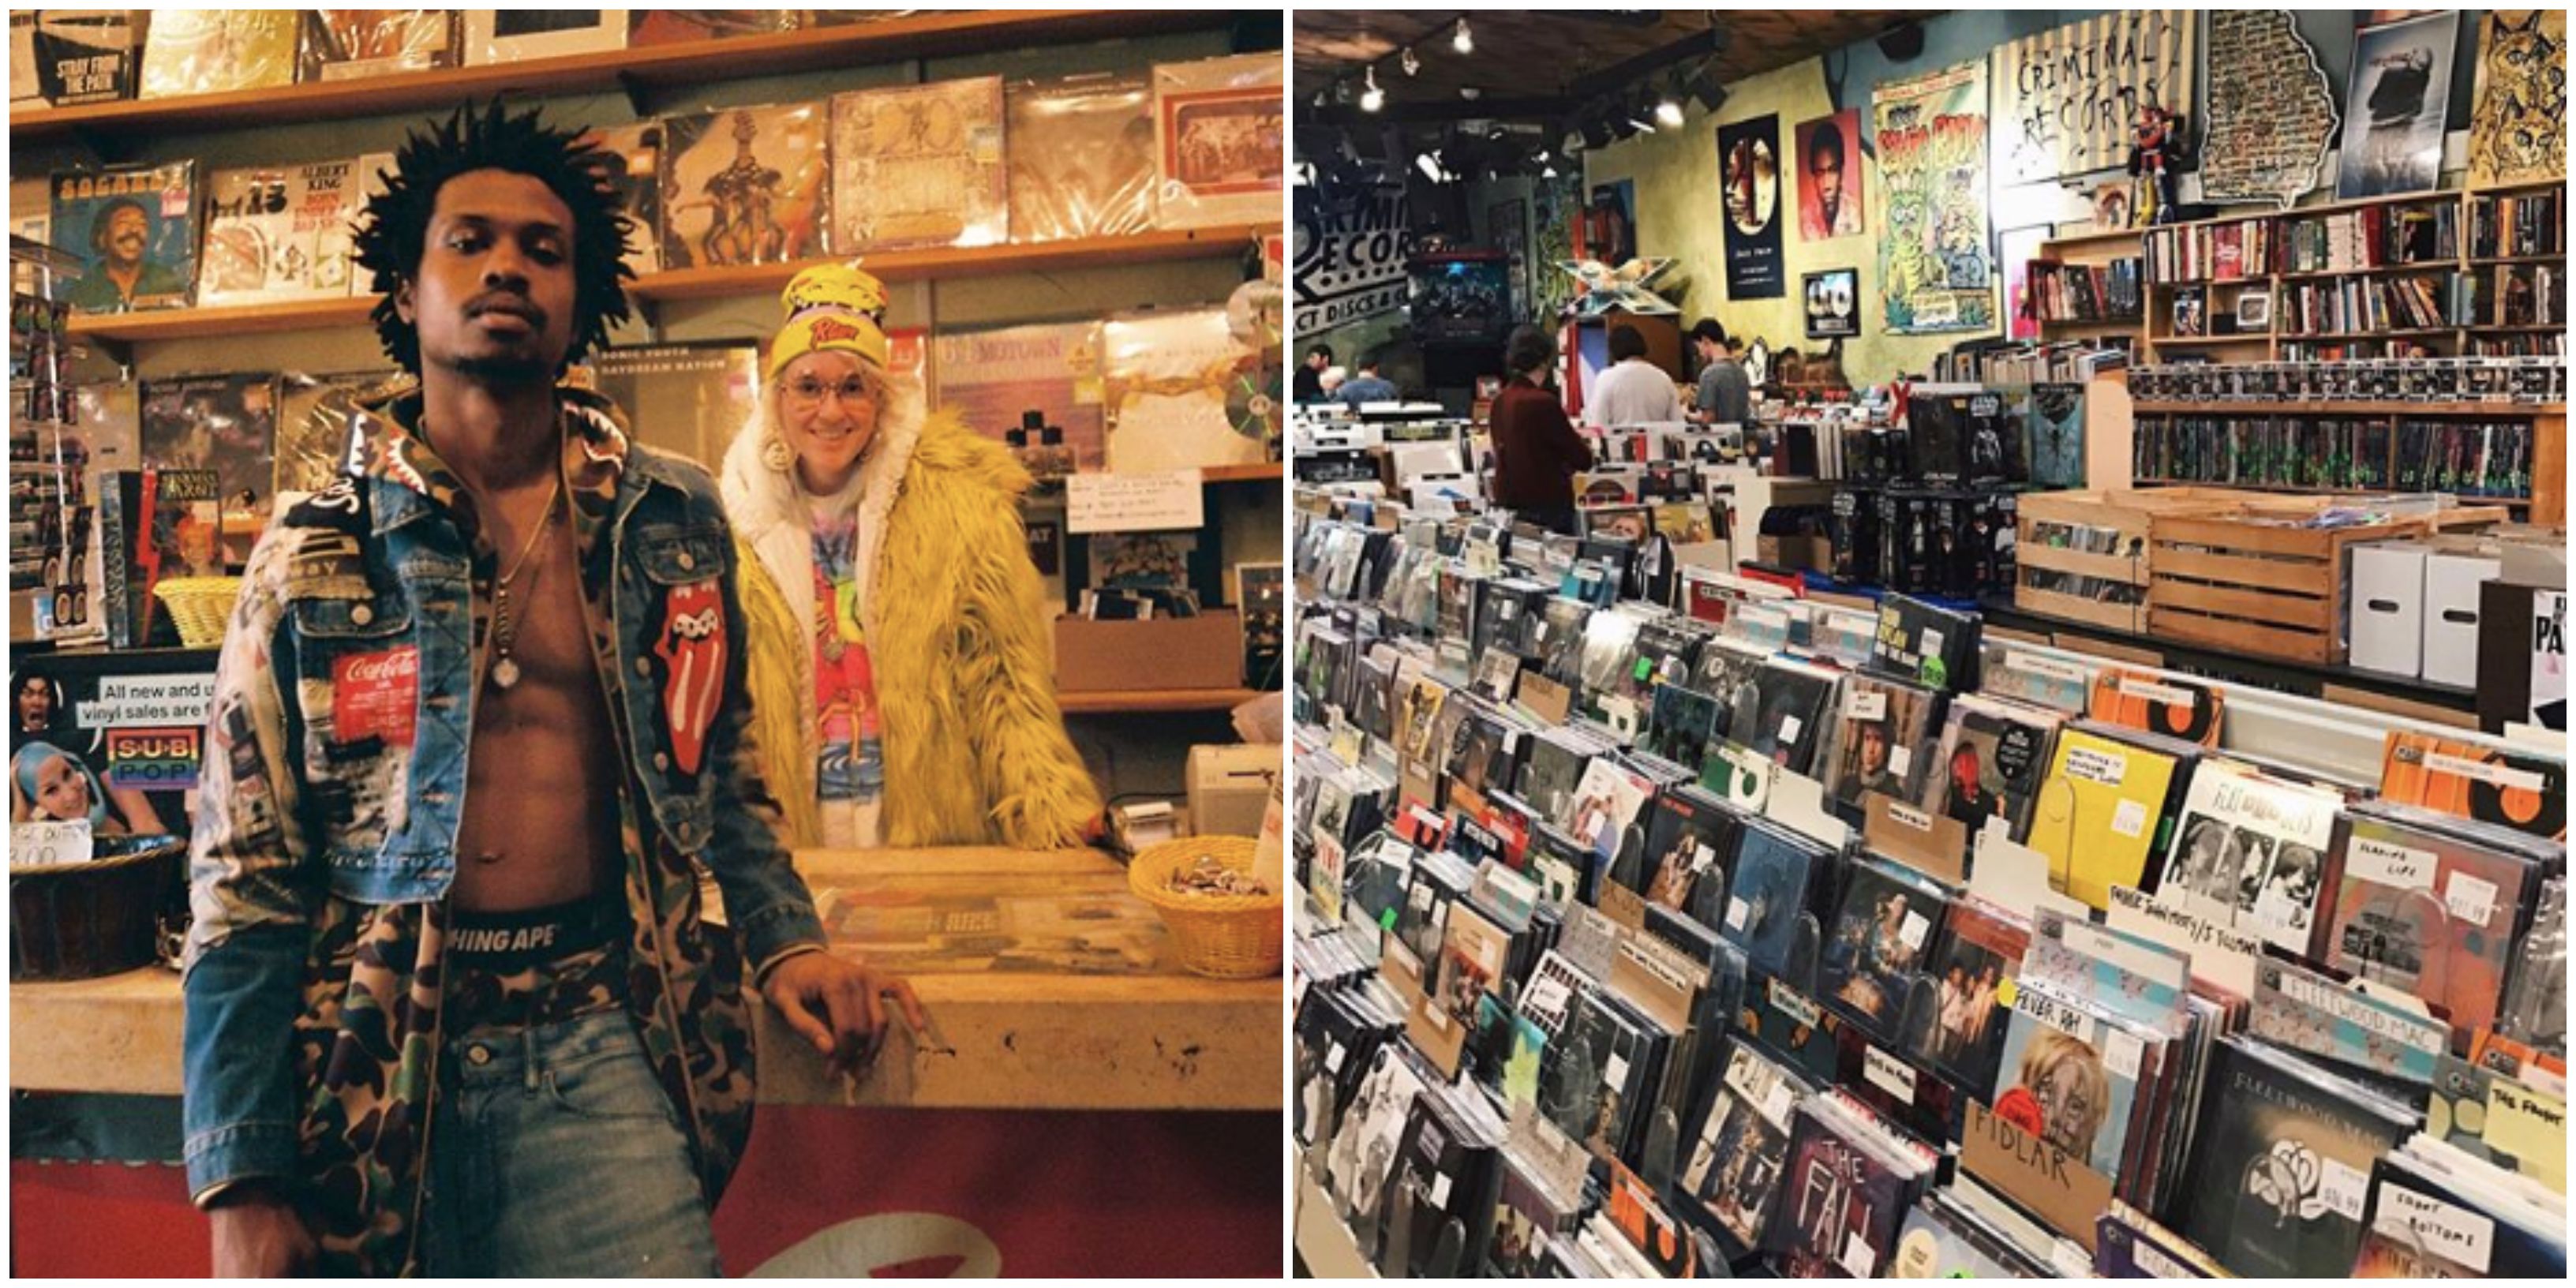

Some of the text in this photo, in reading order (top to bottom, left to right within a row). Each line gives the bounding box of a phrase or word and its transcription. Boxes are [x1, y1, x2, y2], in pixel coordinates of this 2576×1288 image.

[2018, 33, 2156, 95] CRIMINAL
[2022, 77, 2159, 151] RECORDS
[301, 163, 349, 178] ALBERT
[309, 178, 340, 191] KING
[1293, 310, 1318, 331] CT
[601, 346, 689, 360] SONIC YOUTH
[675, 359, 725, 372] NATION
[1030, 526, 1051, 542] AT
[2536, 616, 2566, 654] PA
[104, 684, 126, 699] All
[130, 687, 165, 699] new
[168, 683, 200, 697] and
[82, 705, 122, 723] vinyl
[125, 704, 169, 719] sales
[172, 706, 200, 717] are
[451, 923, 553, 949] HING APE
[1975, 1106, 2071, 1190] FIDLAR
[1821, 1140, 1865, 1183] THE
